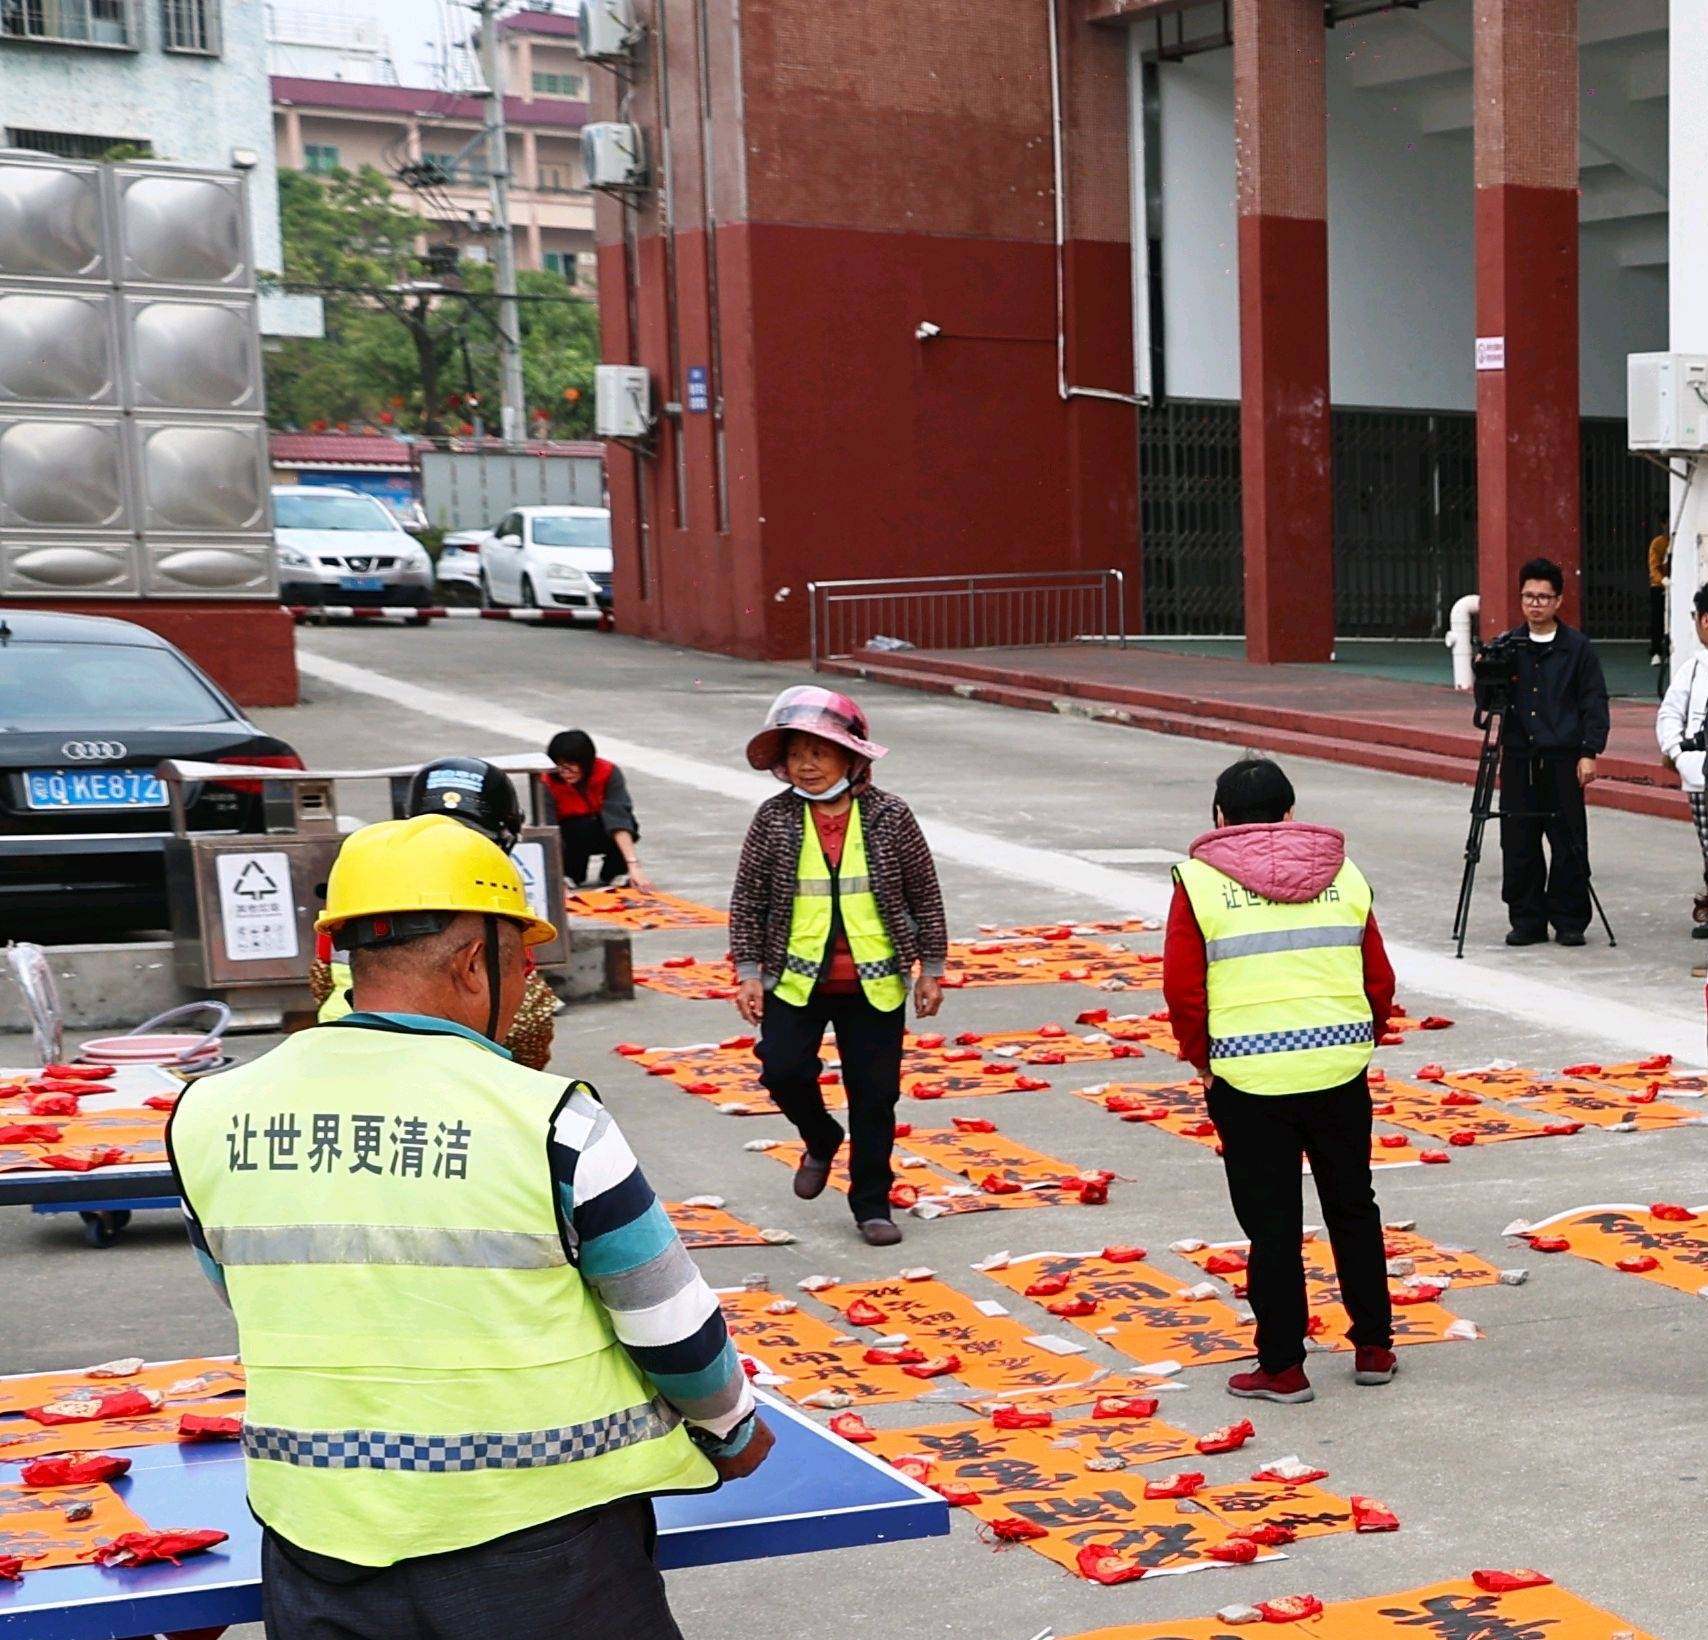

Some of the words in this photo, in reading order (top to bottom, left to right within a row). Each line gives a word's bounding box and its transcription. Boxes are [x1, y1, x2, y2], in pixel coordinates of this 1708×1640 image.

[226, 1112, 472, 1180] 让世界更清洁
